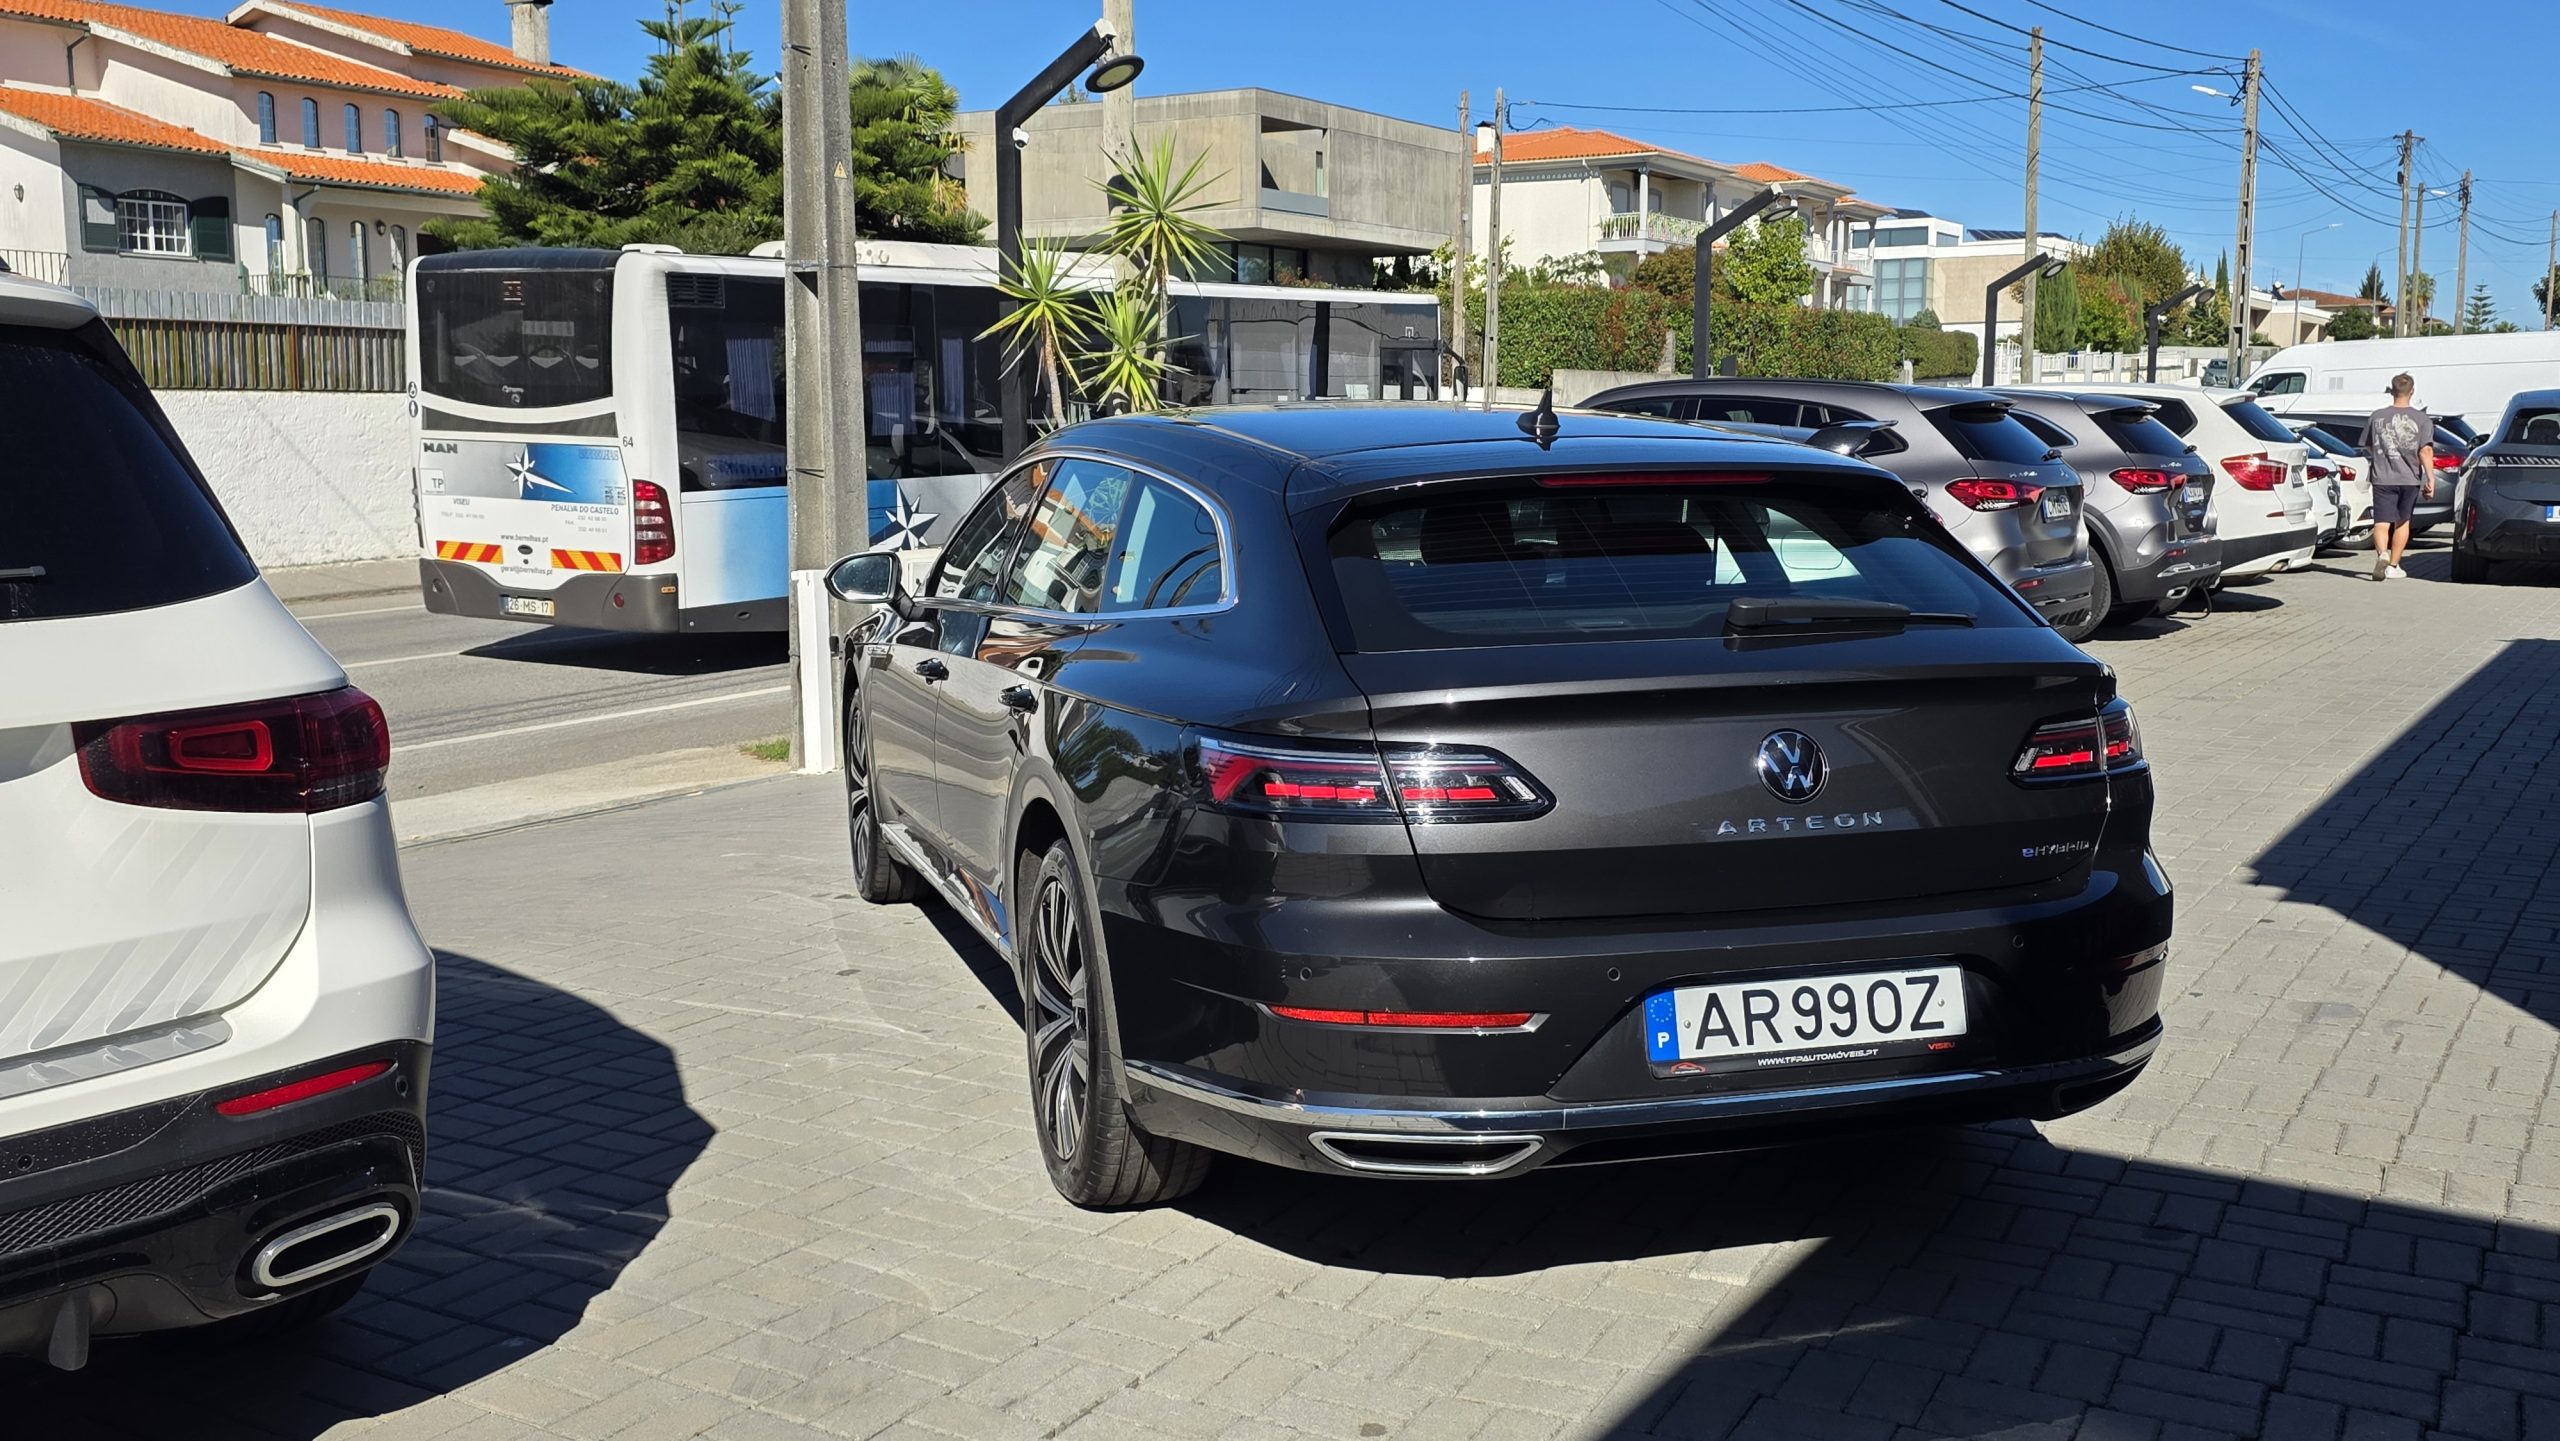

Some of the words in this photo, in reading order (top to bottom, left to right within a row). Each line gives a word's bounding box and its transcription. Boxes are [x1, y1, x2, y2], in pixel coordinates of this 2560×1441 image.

[423, 442, 458, 454] MAN
[622, 436, 634, 448] 64
[432, 478, 444, 489] TP
[551, 504, 578, 513] PENALVA
[580, 506, 589, 514] DO
[590, 506, 619, 516] CASTELO
[1716, 810, 1884, 836] ARTEON
[1657, 1031, 1670, 1048] P
[1927, 1040, 1956, 1052] VISEU
